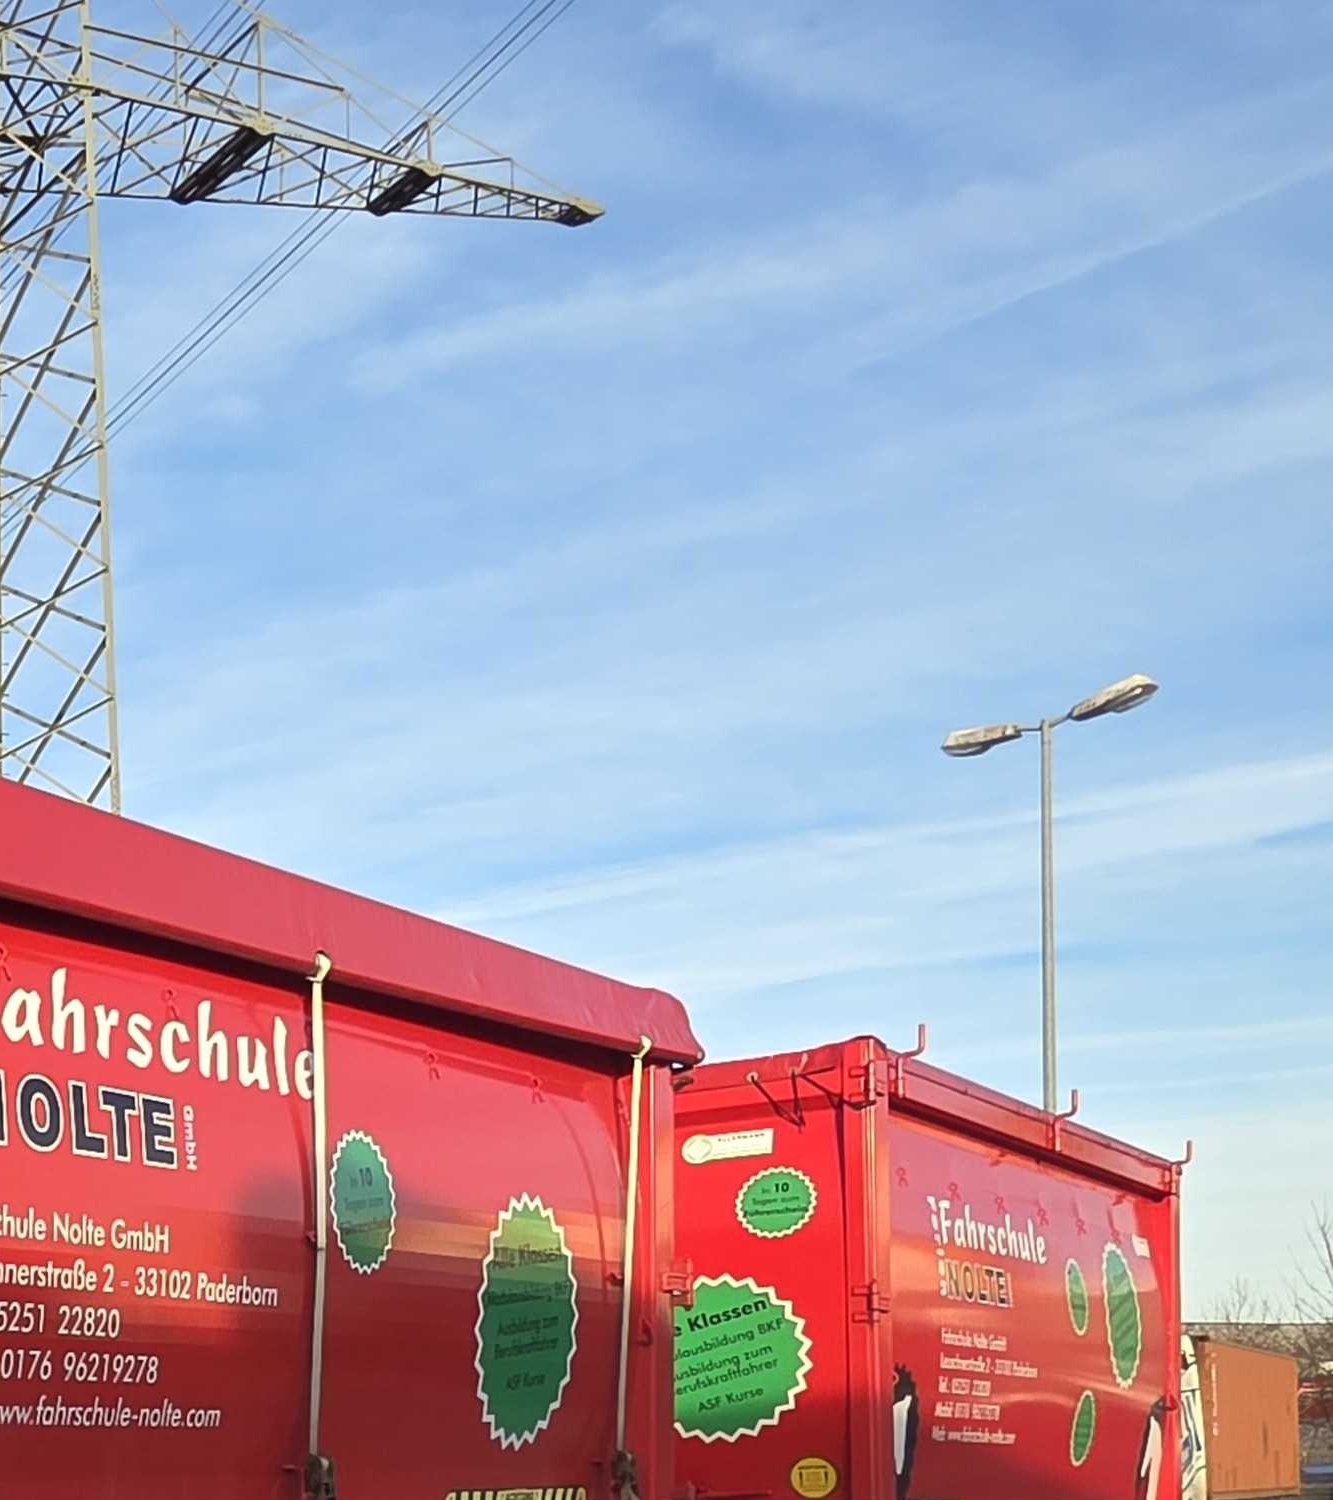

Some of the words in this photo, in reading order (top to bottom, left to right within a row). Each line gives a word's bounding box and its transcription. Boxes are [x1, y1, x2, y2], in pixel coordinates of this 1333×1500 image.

[181, 1105, 199, 1172] GmbH
[359, 1166, 373, 1188] 10
[773, 1182, 790, 1194] 10
[52, 1212, 106, 1248] Nolte
[110, 1219, 170, 1254] GmbH
[938, 1199, 1048, 1265] Fahrschule
[102, 1264, 115, 1294] 2
[133, 1266, 192, 1300] 33102
[196, 1272, 279, 1307] Paderborn
[944, 1259, 1010, 1308] NOLTE
[56, 1305, 121, 1339] 22820
[687, 1299, 767, 1333] Klassen
[674, 1329, 755, 1361] lausbildung
[757, 1318, 784, 1336] BKF
[0, 1348, 53, 1381] 0176
[62, 1351, 160, 1384] 96219278
[674, 1355, 741, 1381] usbildung
[744, 1346, 773, 1361] zum
[675, 1358, 779, 1396] erufskraftfahrer
[698, 1395, 722, 1414] ASF
[724, 1386, 765, 1406] Kurse
